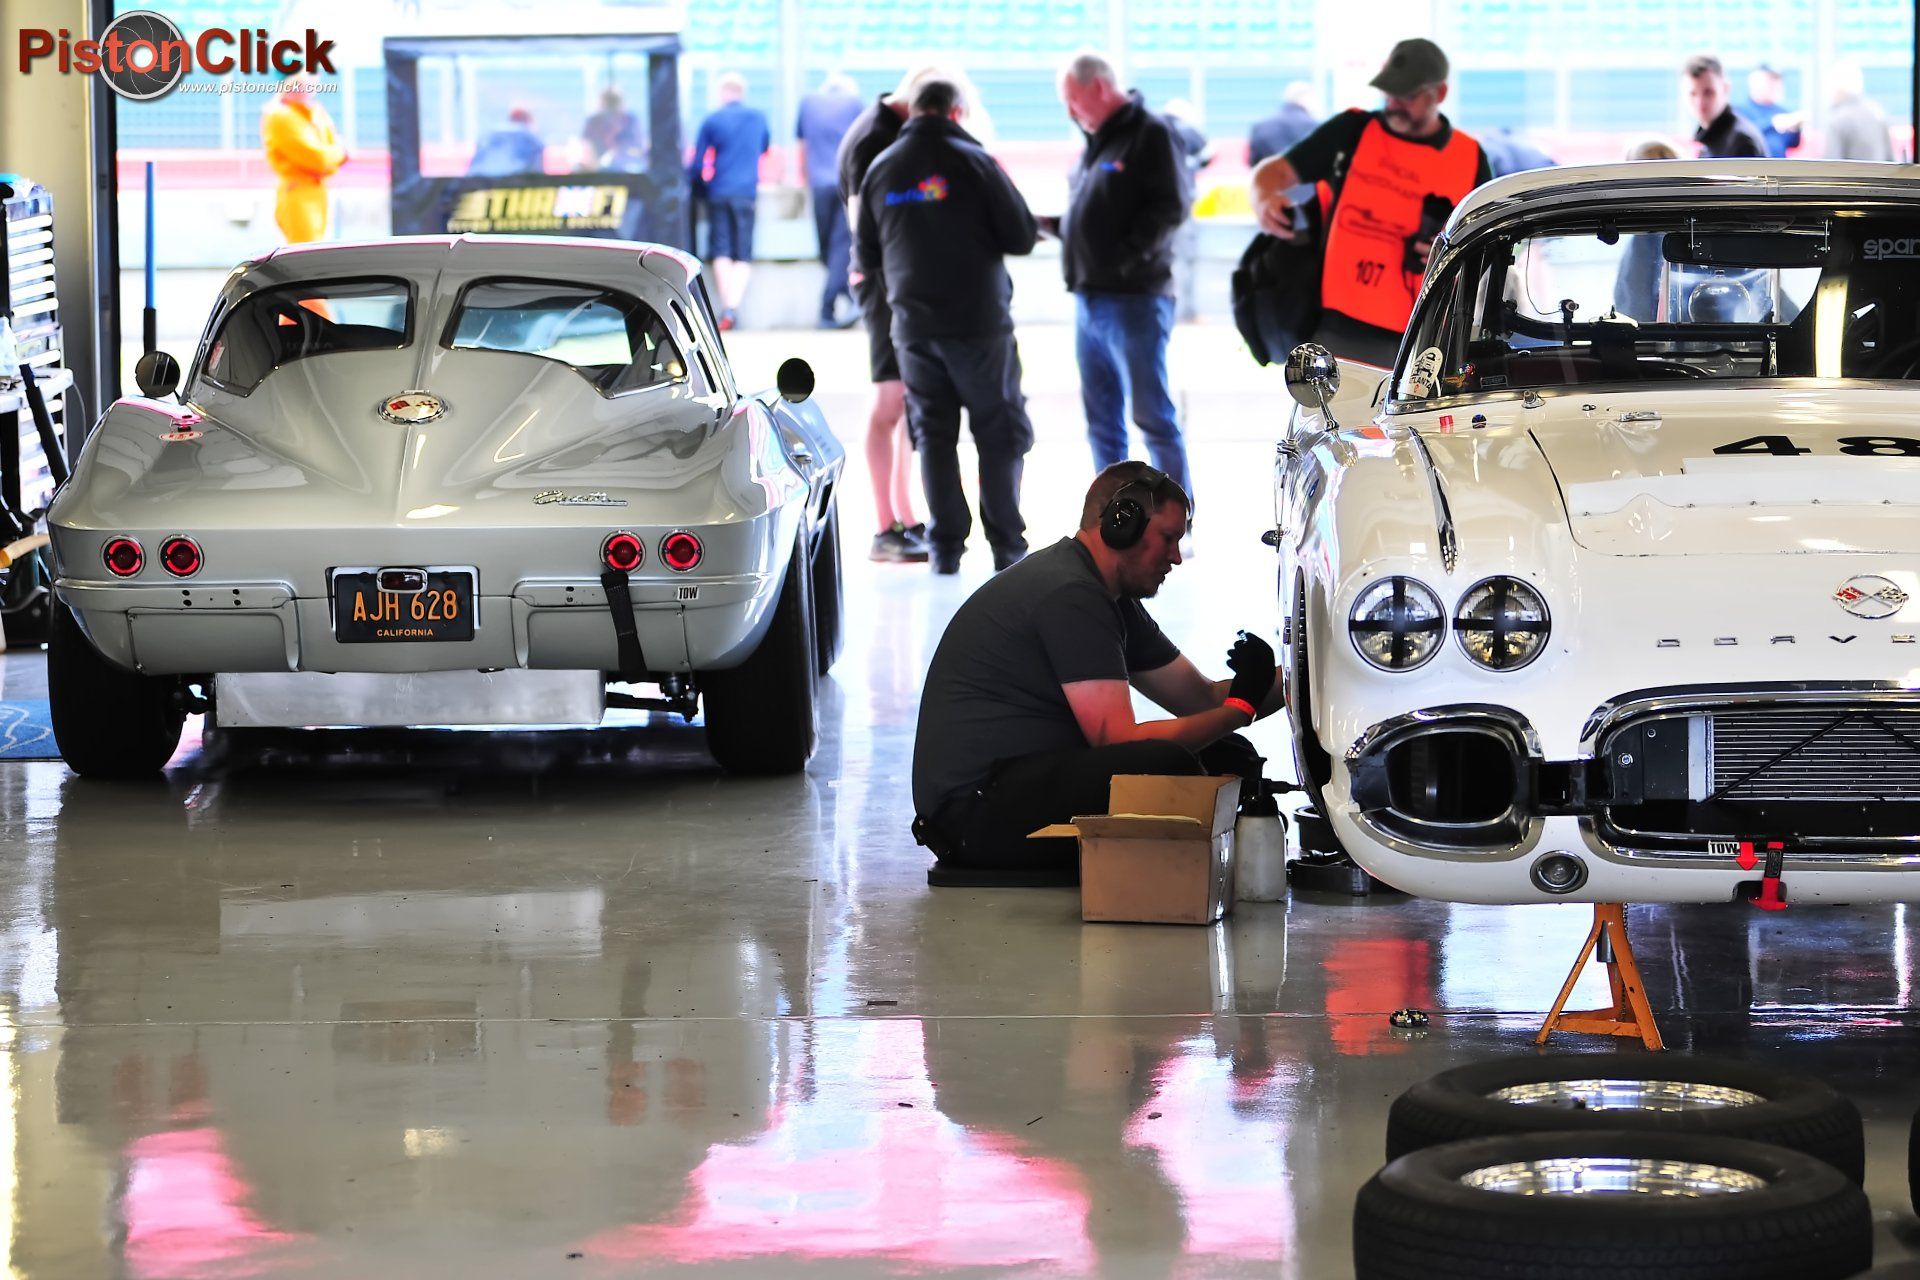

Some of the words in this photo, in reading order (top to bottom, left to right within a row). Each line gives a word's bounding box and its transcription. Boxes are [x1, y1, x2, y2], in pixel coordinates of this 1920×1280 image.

[1356, 259, 1385, 287] 107
[678, 586, 698, 599] TOW
[353, 591, 399, 621] AJH
[411, 590, 457, 621] 628
[376, 628, 434, 637] CALIFORNIA
[1710, 843, 1739, 854] TOW
